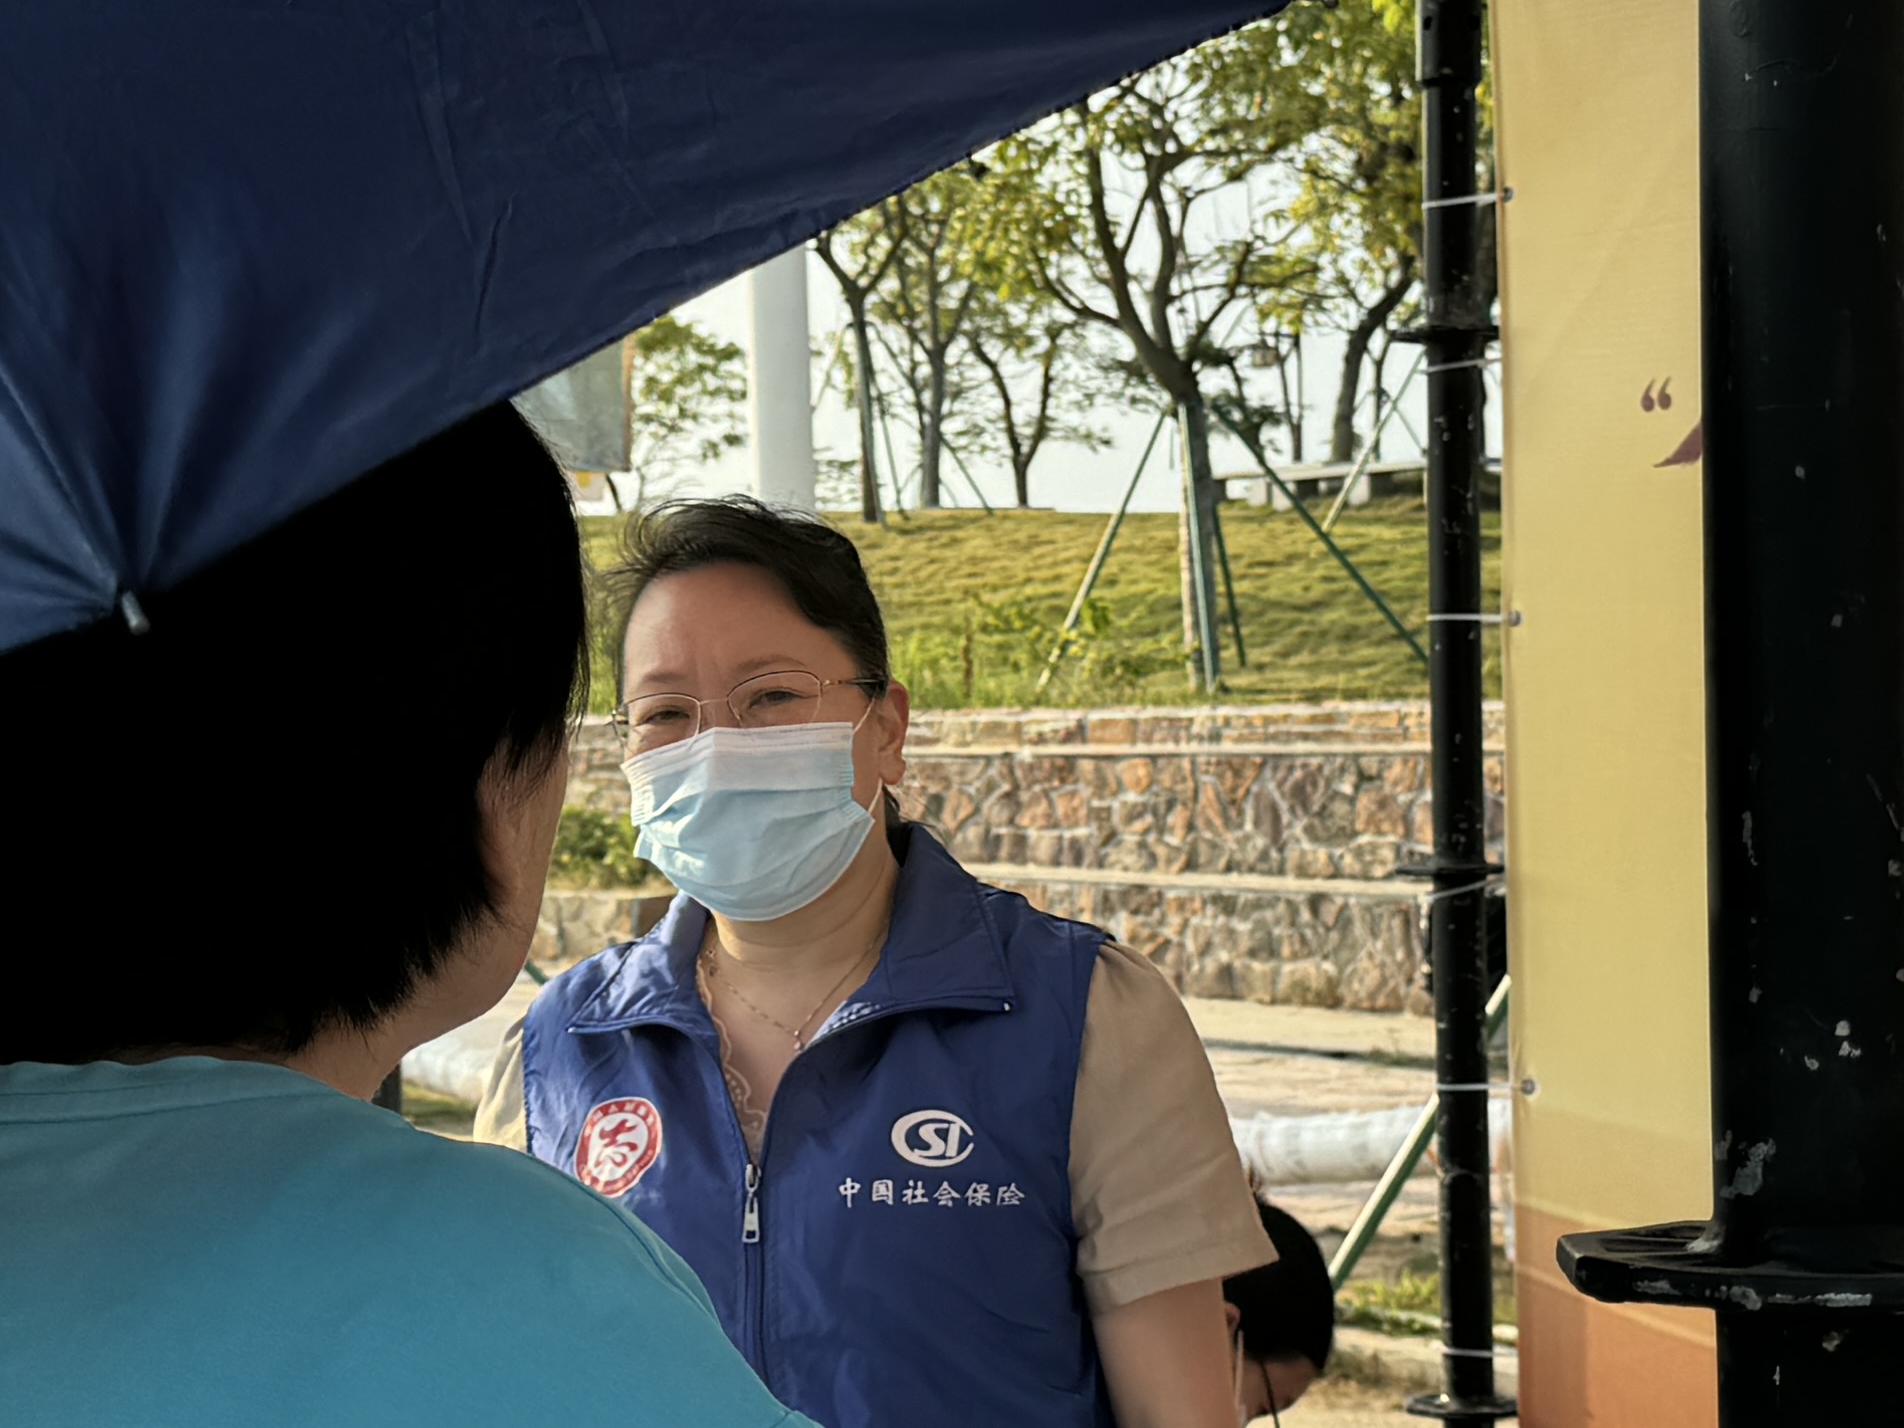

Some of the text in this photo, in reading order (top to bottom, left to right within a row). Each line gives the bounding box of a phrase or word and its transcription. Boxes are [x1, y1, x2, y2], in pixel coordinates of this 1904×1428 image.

[838, 1177, 1025, 1209] 中国社会保险
